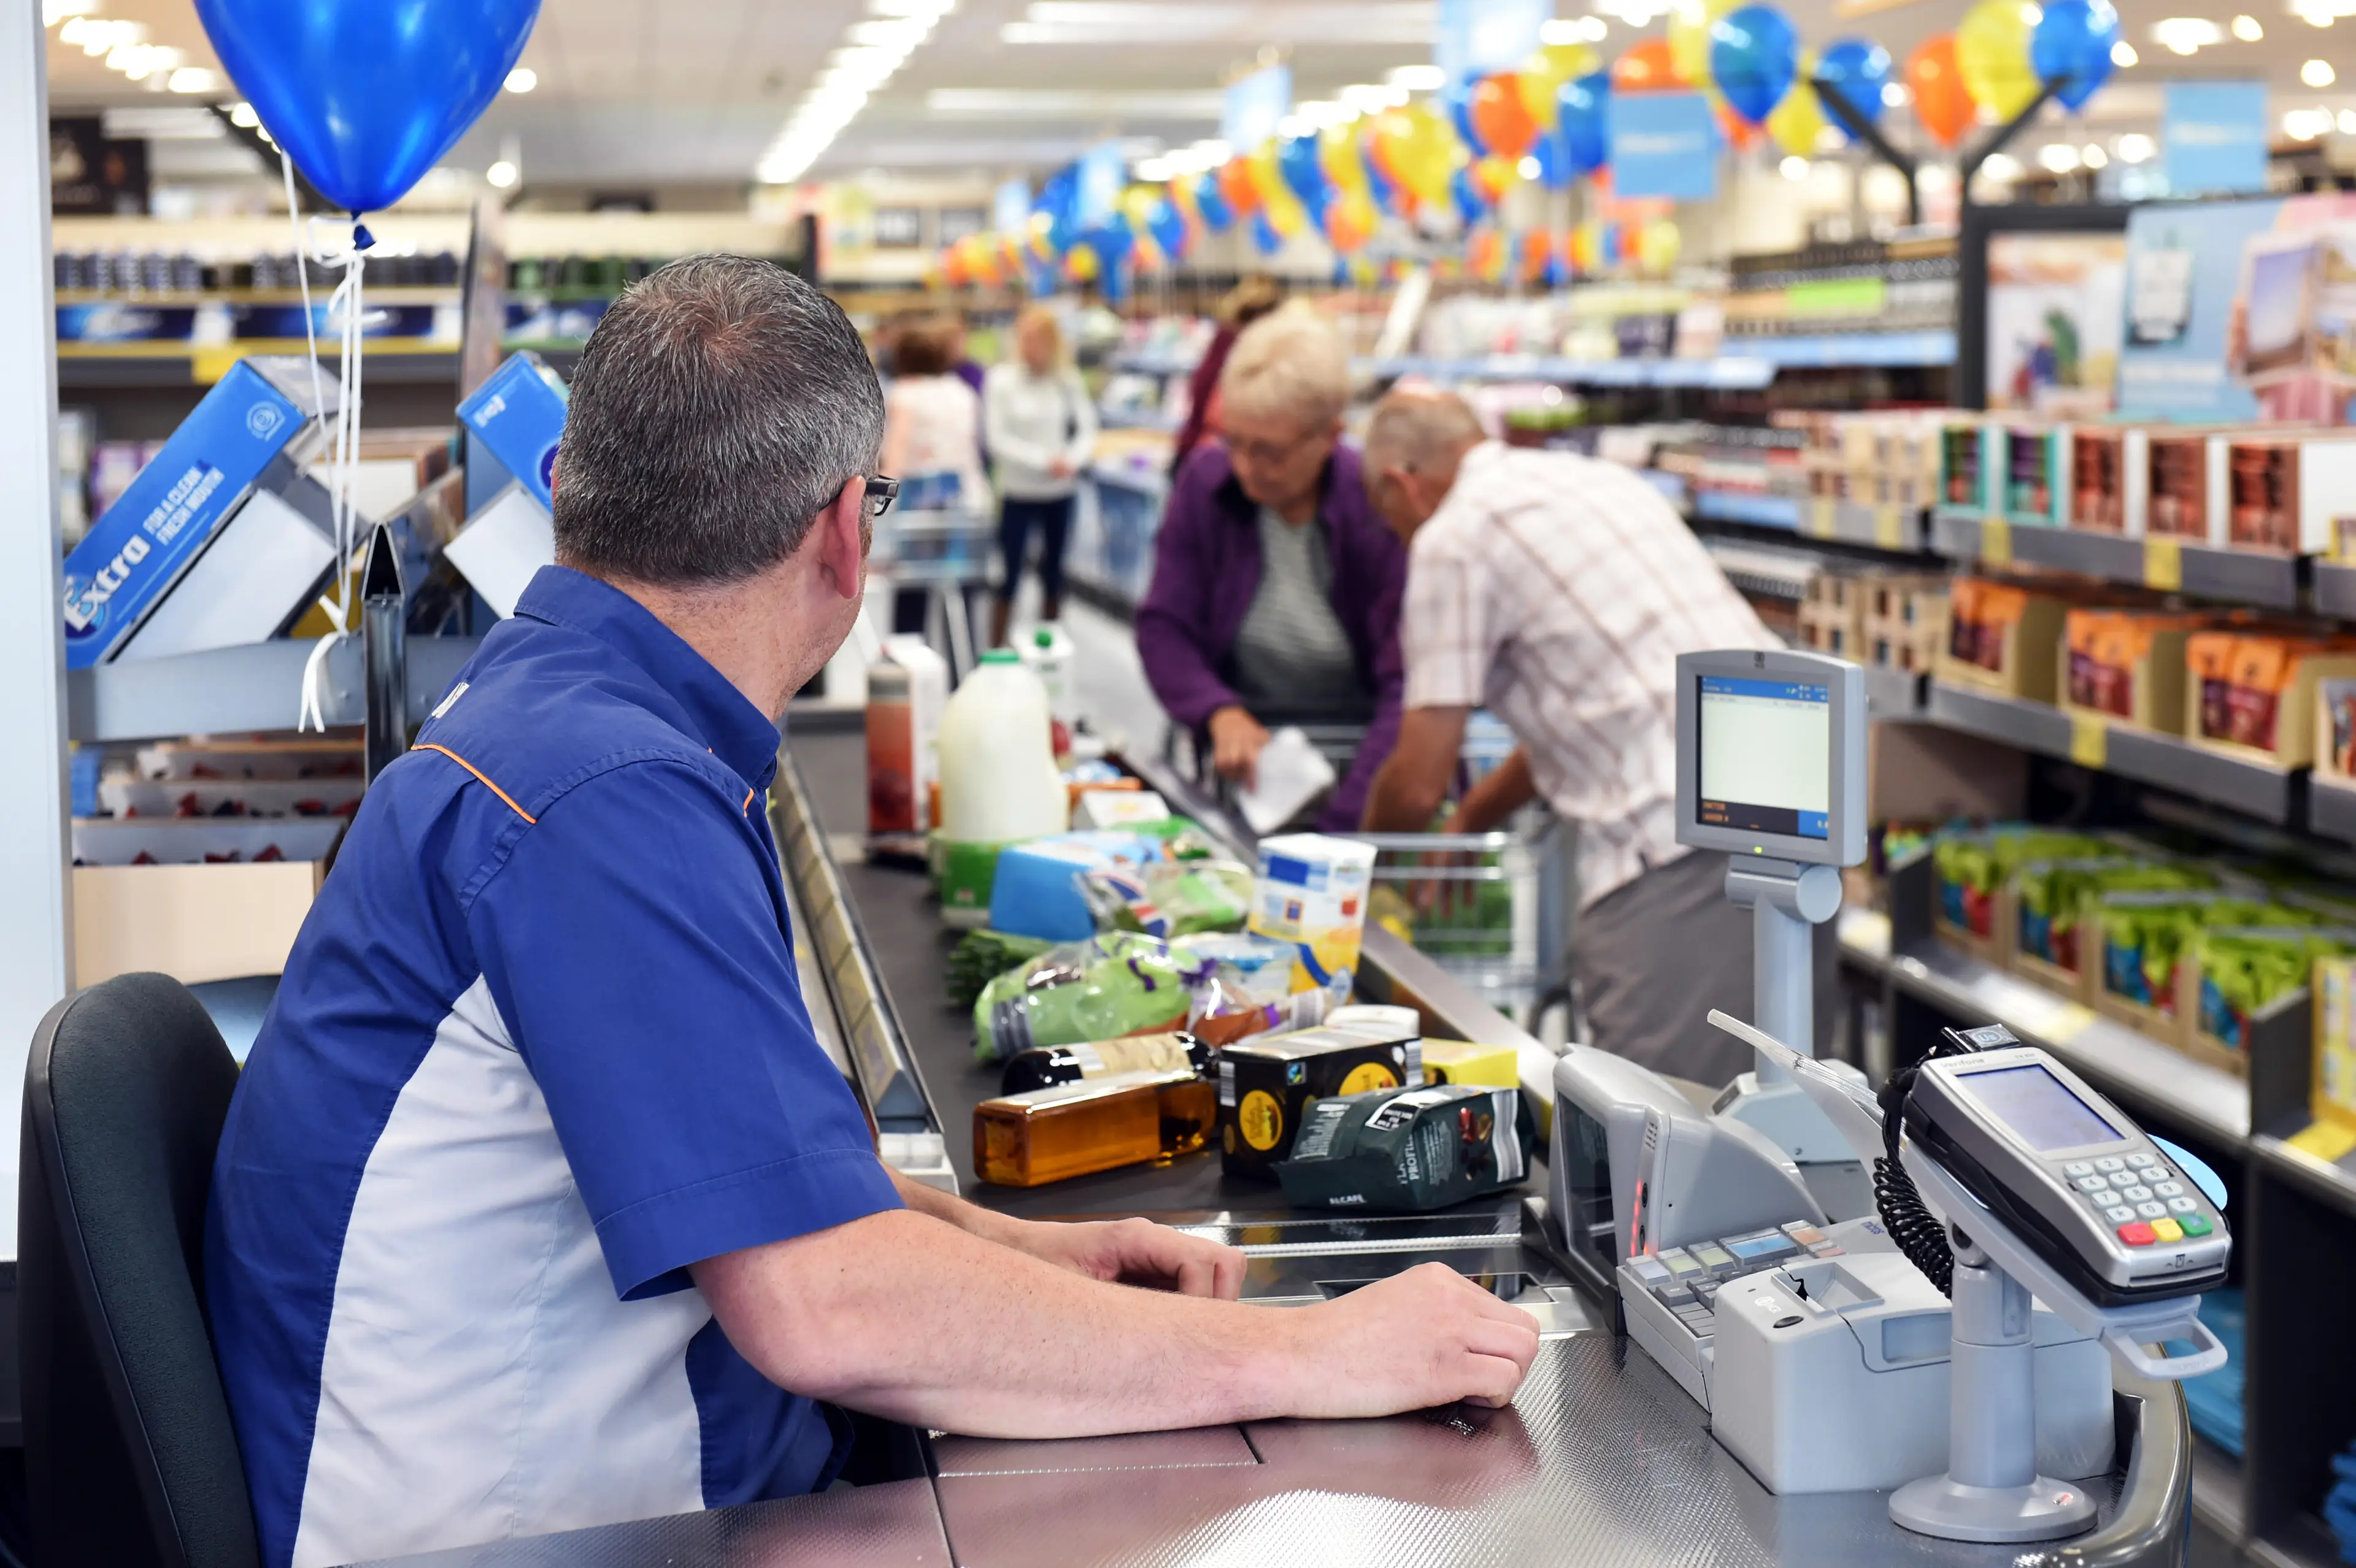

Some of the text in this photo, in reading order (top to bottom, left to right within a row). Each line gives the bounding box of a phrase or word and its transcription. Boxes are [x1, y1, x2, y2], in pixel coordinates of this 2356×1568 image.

[156, 504, 193, 545] FRESH
[63, 532, 151, 632] Extra
[2163, 1185, 2173, 1193] 9
